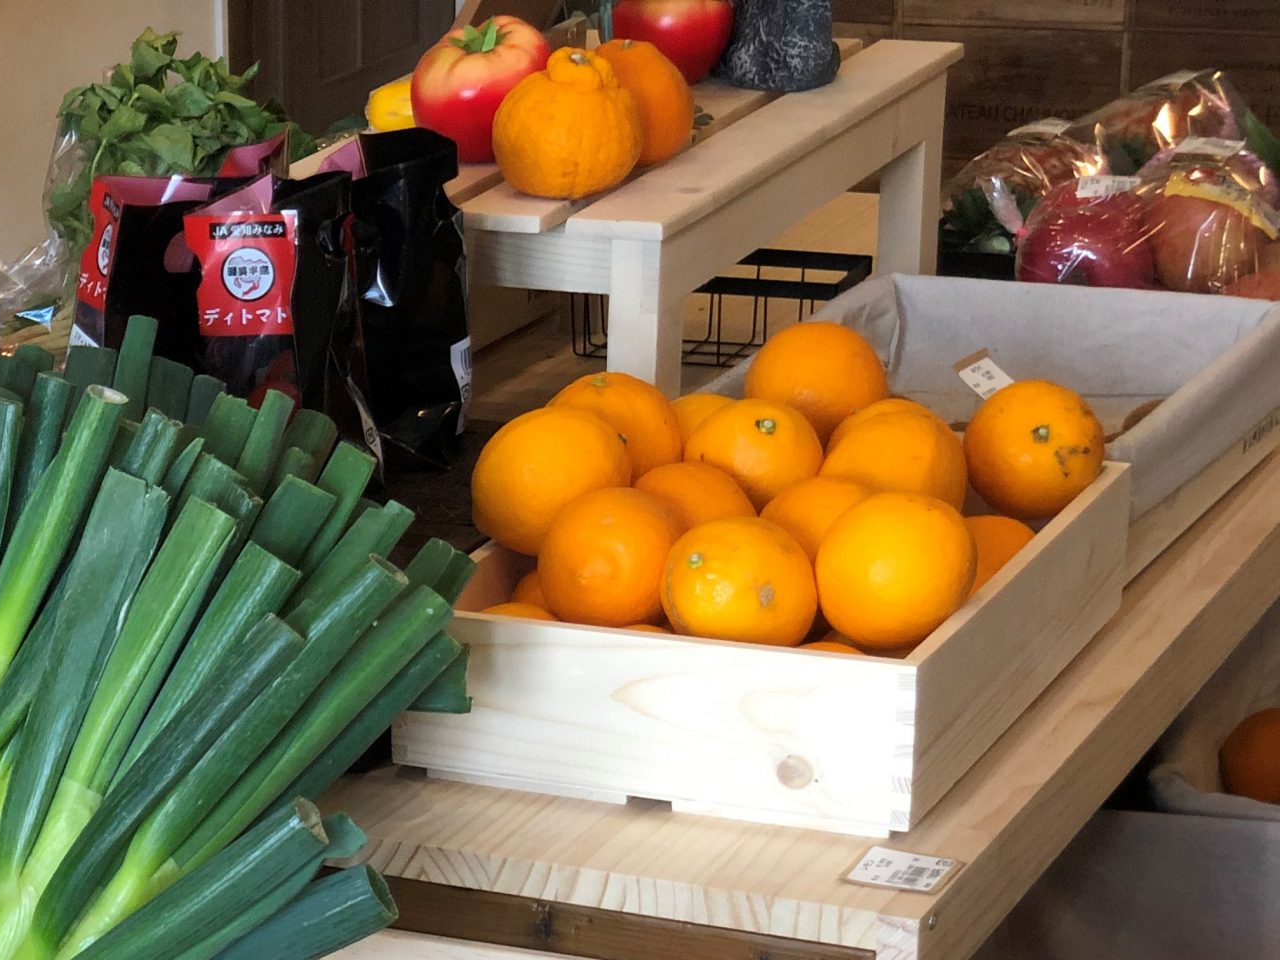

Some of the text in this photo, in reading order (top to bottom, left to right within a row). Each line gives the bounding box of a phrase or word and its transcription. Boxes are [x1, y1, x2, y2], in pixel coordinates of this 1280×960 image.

[199, 307, 287, 326] ディトマト
